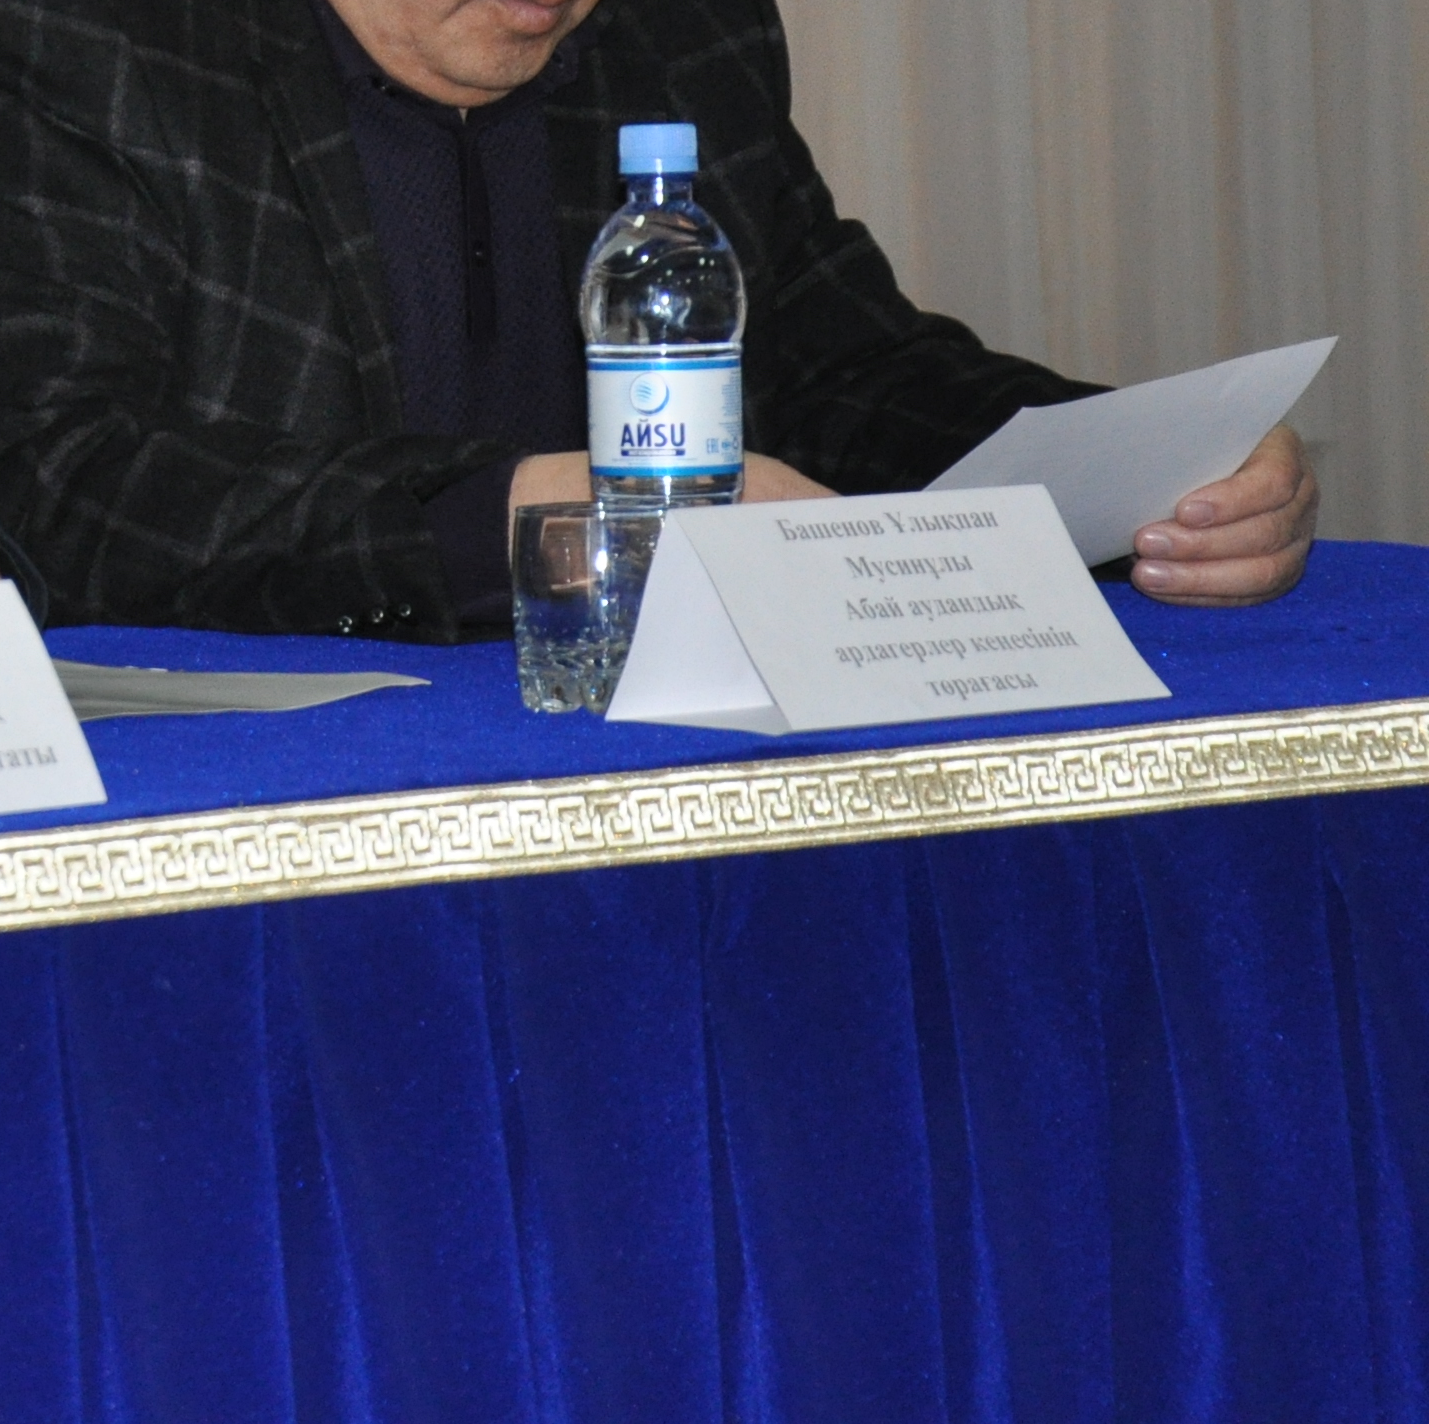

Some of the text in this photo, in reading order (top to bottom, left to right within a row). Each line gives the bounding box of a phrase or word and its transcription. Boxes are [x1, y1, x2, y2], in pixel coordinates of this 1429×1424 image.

[775, 510, 999, 542] Башенов Ұлықпан
[844, 554, 975, 583] Мусинұлы
[844, 592, 1026, 622] Абай аудандық
[834, 636, 967, 669] ардагерлер
[925, 672, 1039, 701] төрағасы
